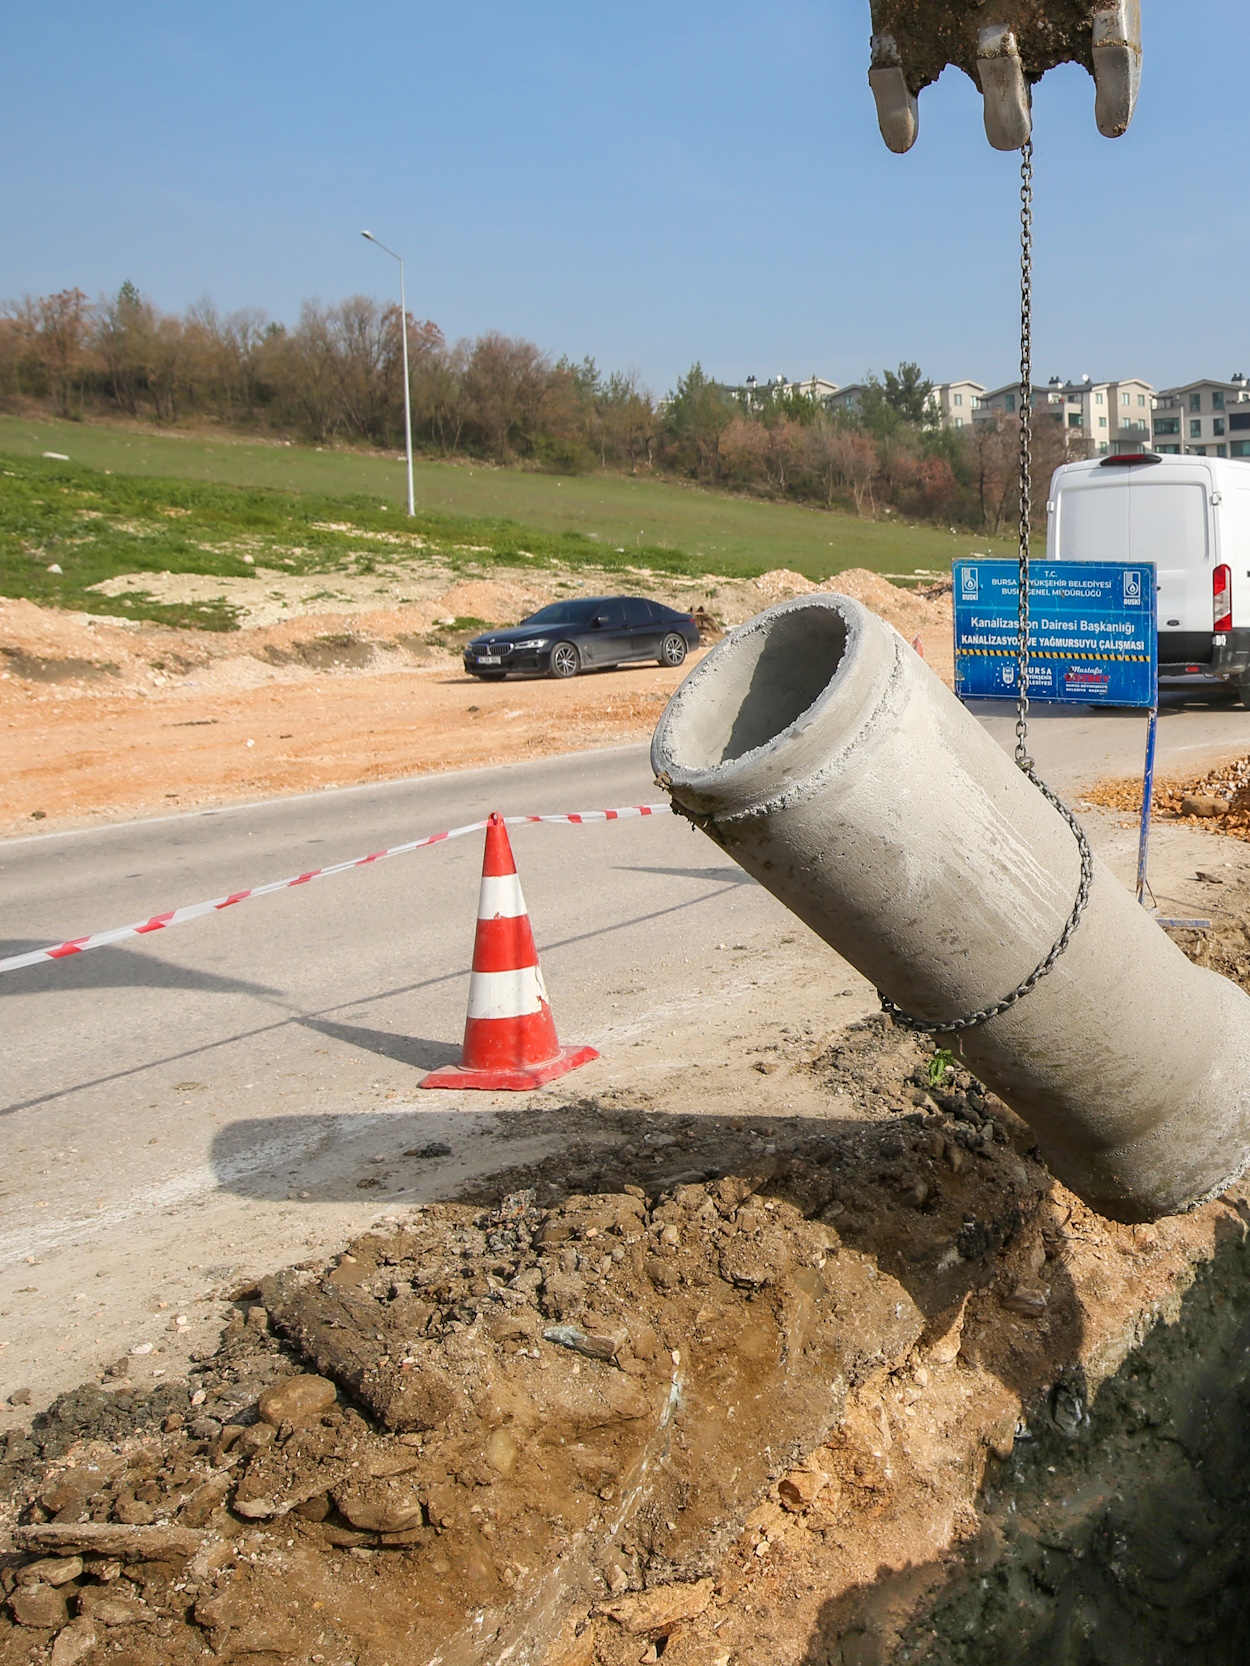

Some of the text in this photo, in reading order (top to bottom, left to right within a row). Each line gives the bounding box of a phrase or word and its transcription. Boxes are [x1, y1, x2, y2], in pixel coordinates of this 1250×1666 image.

[1044, 570, 1058, 578] T.C.
[991, 578, 1018, 586] BURSA
[1068, 579, 1112, 589] BELEDİYESİ
[1051, 587, 1102, 598] MÜDÜRLÜĞÜ
[1041, 618, 1078, 631] Dairesi
[1080, 620, 1135, 635] Başkanlığı
[1038, 635, 1098, 649] YAĞMURSUYU
[1098, 639, 1145, 652] ÇALIŞMASI
